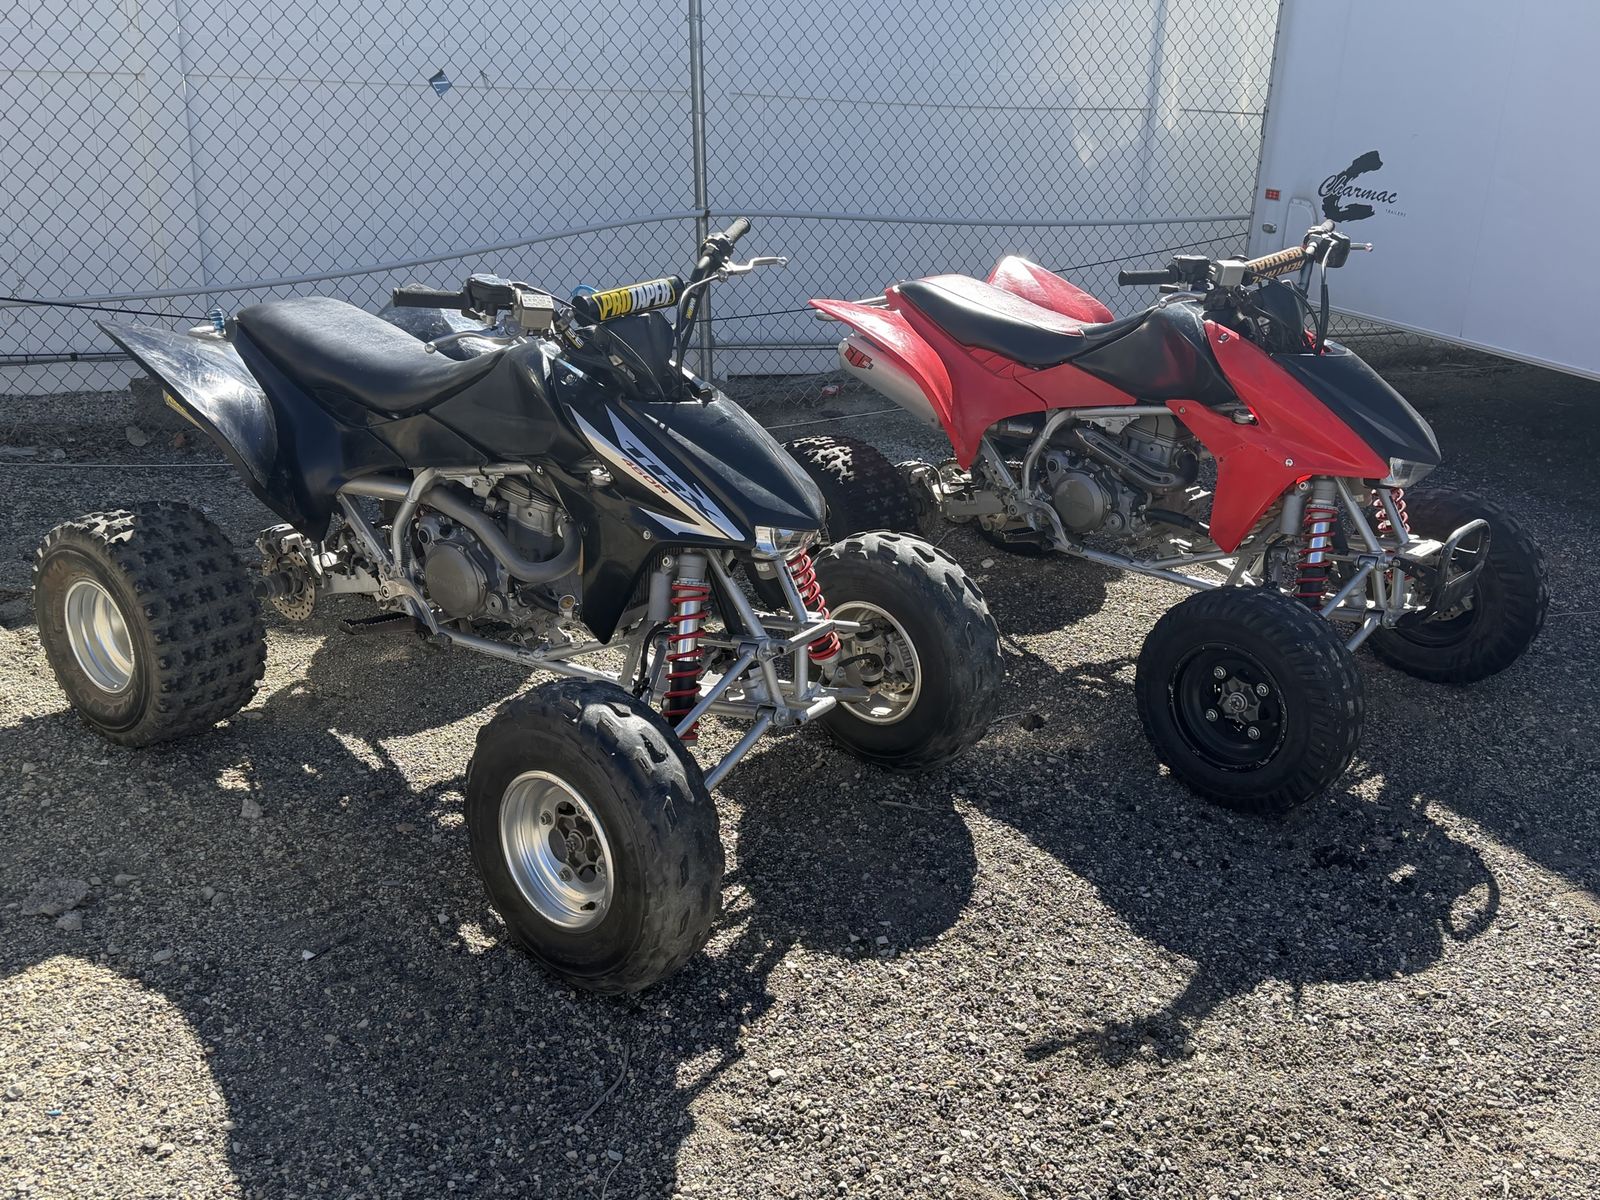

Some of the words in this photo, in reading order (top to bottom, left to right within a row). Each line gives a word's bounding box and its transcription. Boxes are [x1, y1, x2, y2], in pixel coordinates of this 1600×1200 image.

[1318, 174, 1397, 204] Charmac
[1249, 248, 1303, 272] RENTHAL
[621, 457, 669, 495] 450R
